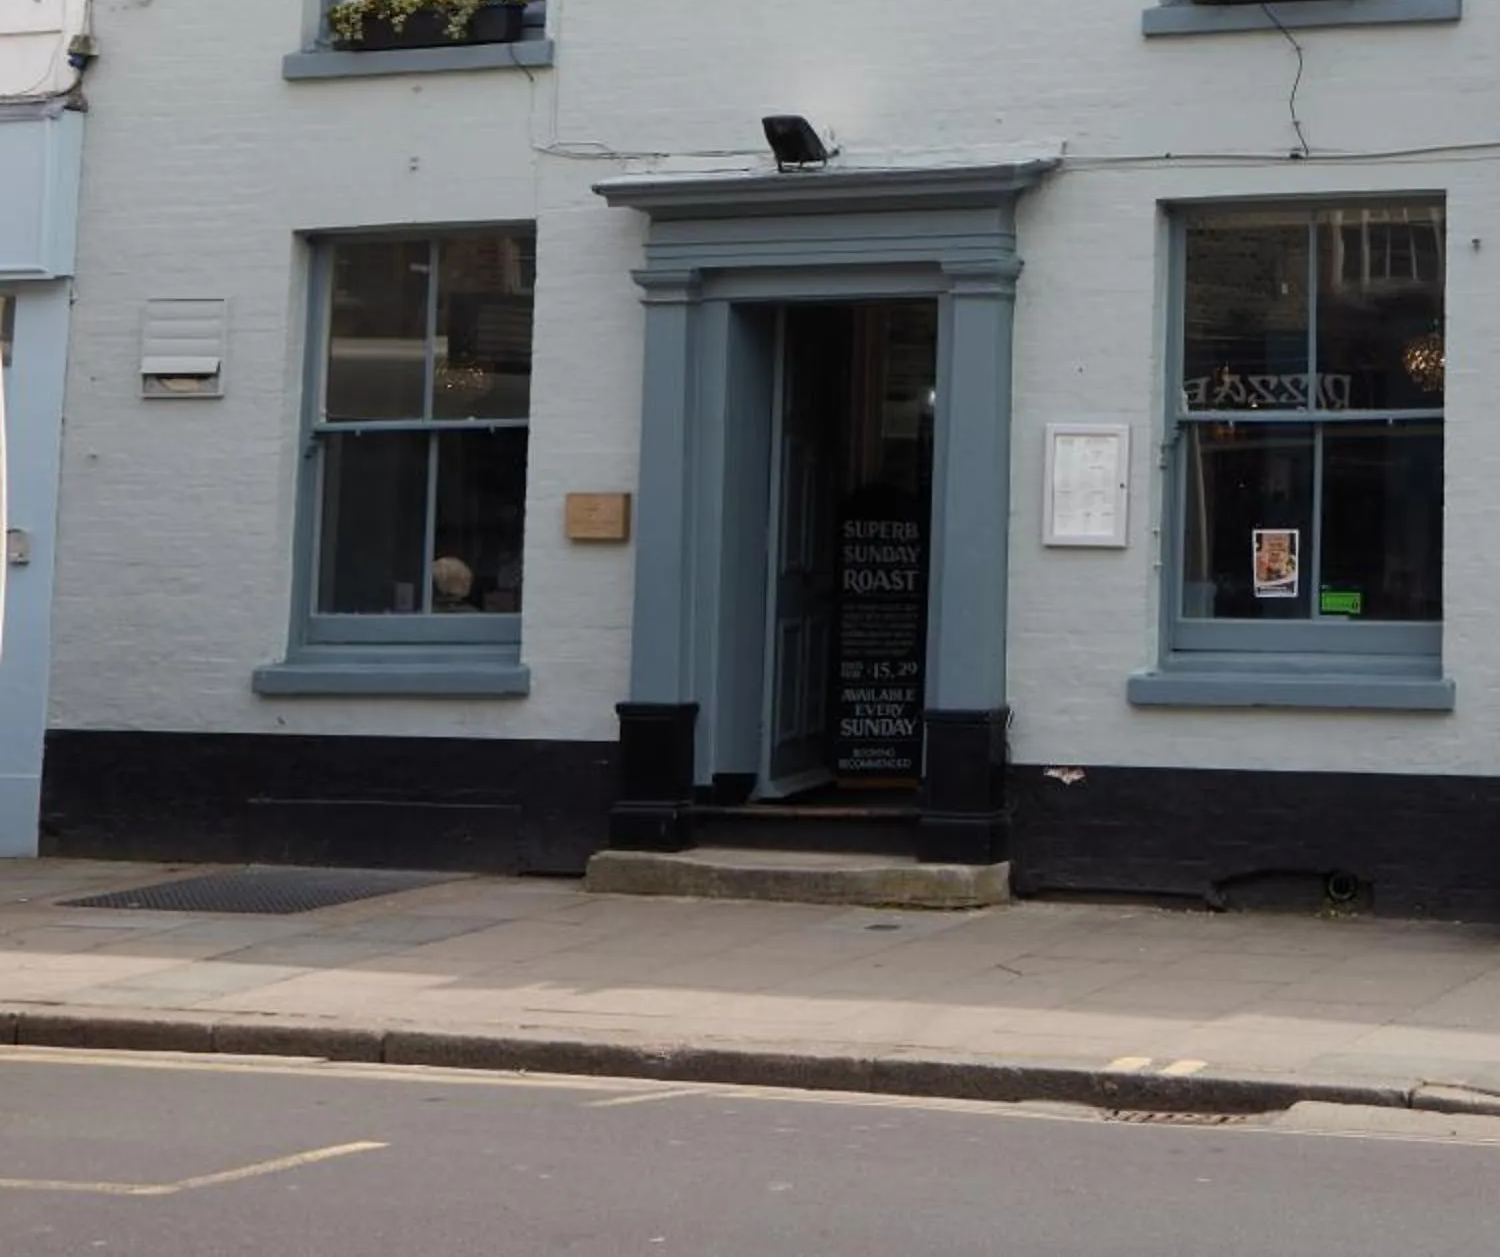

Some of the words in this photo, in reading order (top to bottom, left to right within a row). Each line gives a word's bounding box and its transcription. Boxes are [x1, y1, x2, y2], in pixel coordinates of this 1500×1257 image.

[842, 520, 920, 541] SUPERB
[843, 545, 921, 564] SUNDAY
[843, 569, 920, 593] ROAST
[841, 688, 916, 703] AVAILABLE
[855, 703, 905, 718] EVERY
[840, 718, 917, 737] SUNDAY
